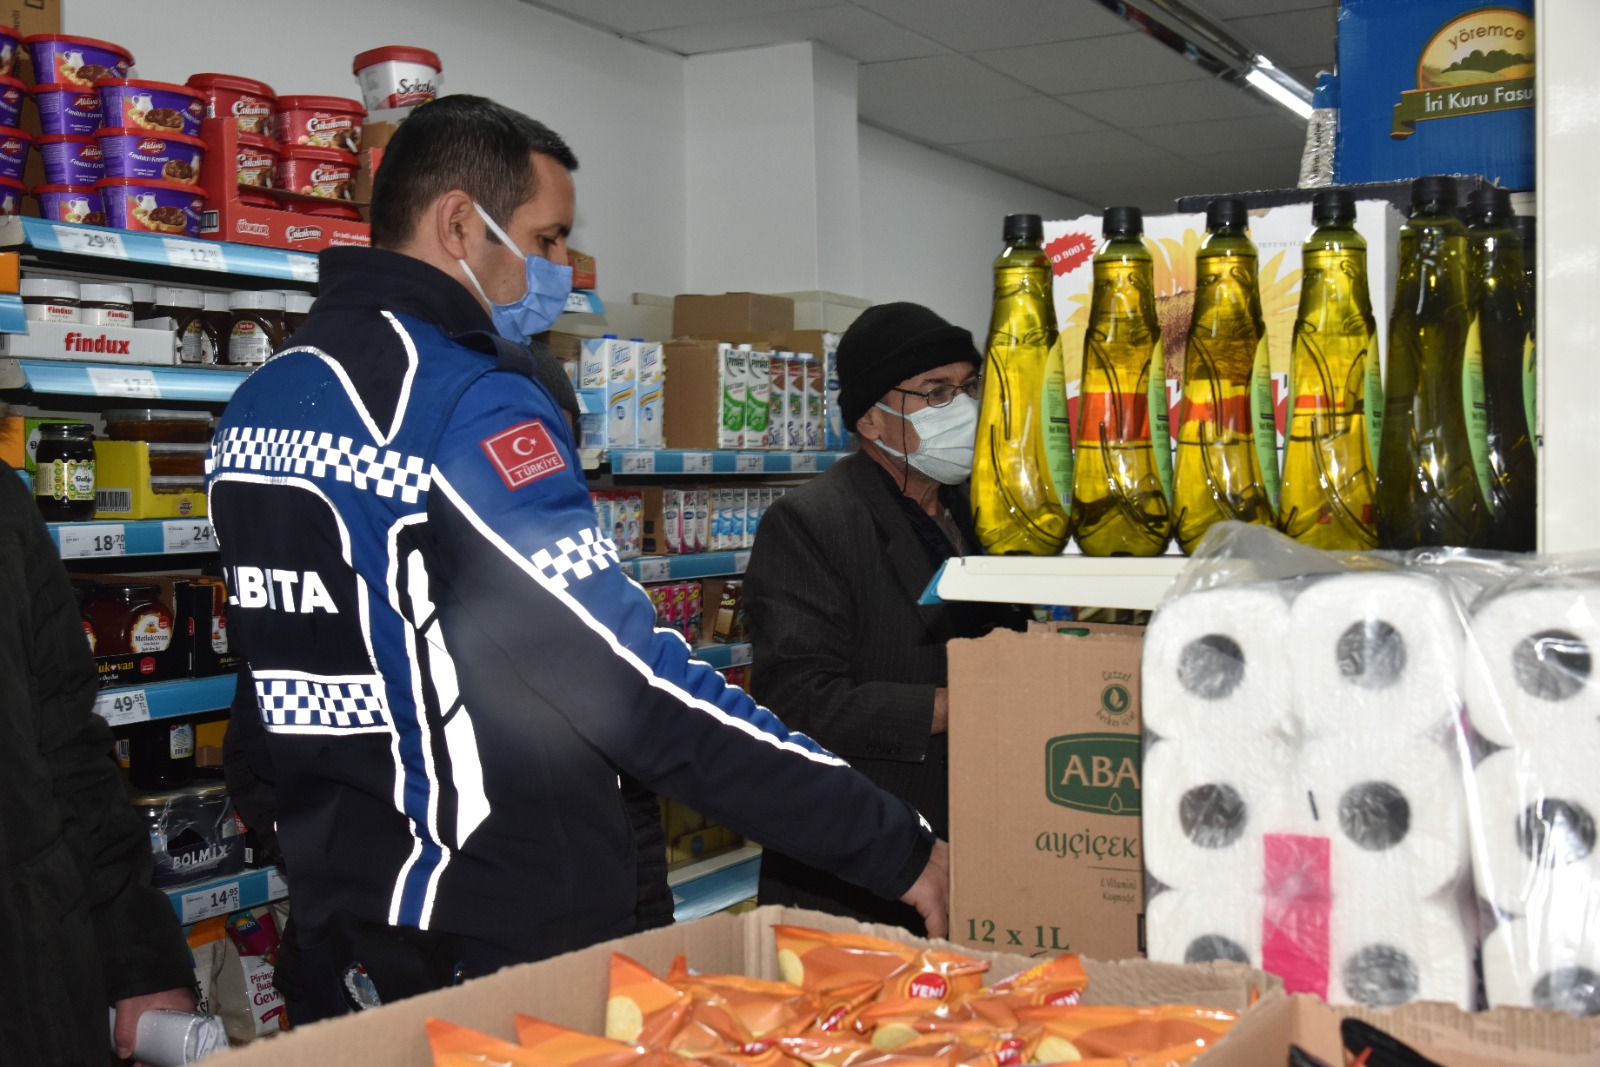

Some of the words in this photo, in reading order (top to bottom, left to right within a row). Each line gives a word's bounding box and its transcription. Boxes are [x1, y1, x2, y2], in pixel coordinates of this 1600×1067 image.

[1448, 24, 1525, 50] yöremce
[1425, 92, 1443, 112] İri
[1448, 92, 1488, 110] Kuru
[1062, 242, 1086, 261] 9001
[65, 332, 131, 354] findux
[515, 456, 559, 479] TÜRKİYE
[1060, 754, 1141, 789] ABA
[967, 918, 996, 944] 12
[1006, 929, 1023, 946] x
[1035, 925, 1070, 951] 1L
[911, 982, 944, 999] YENİ
